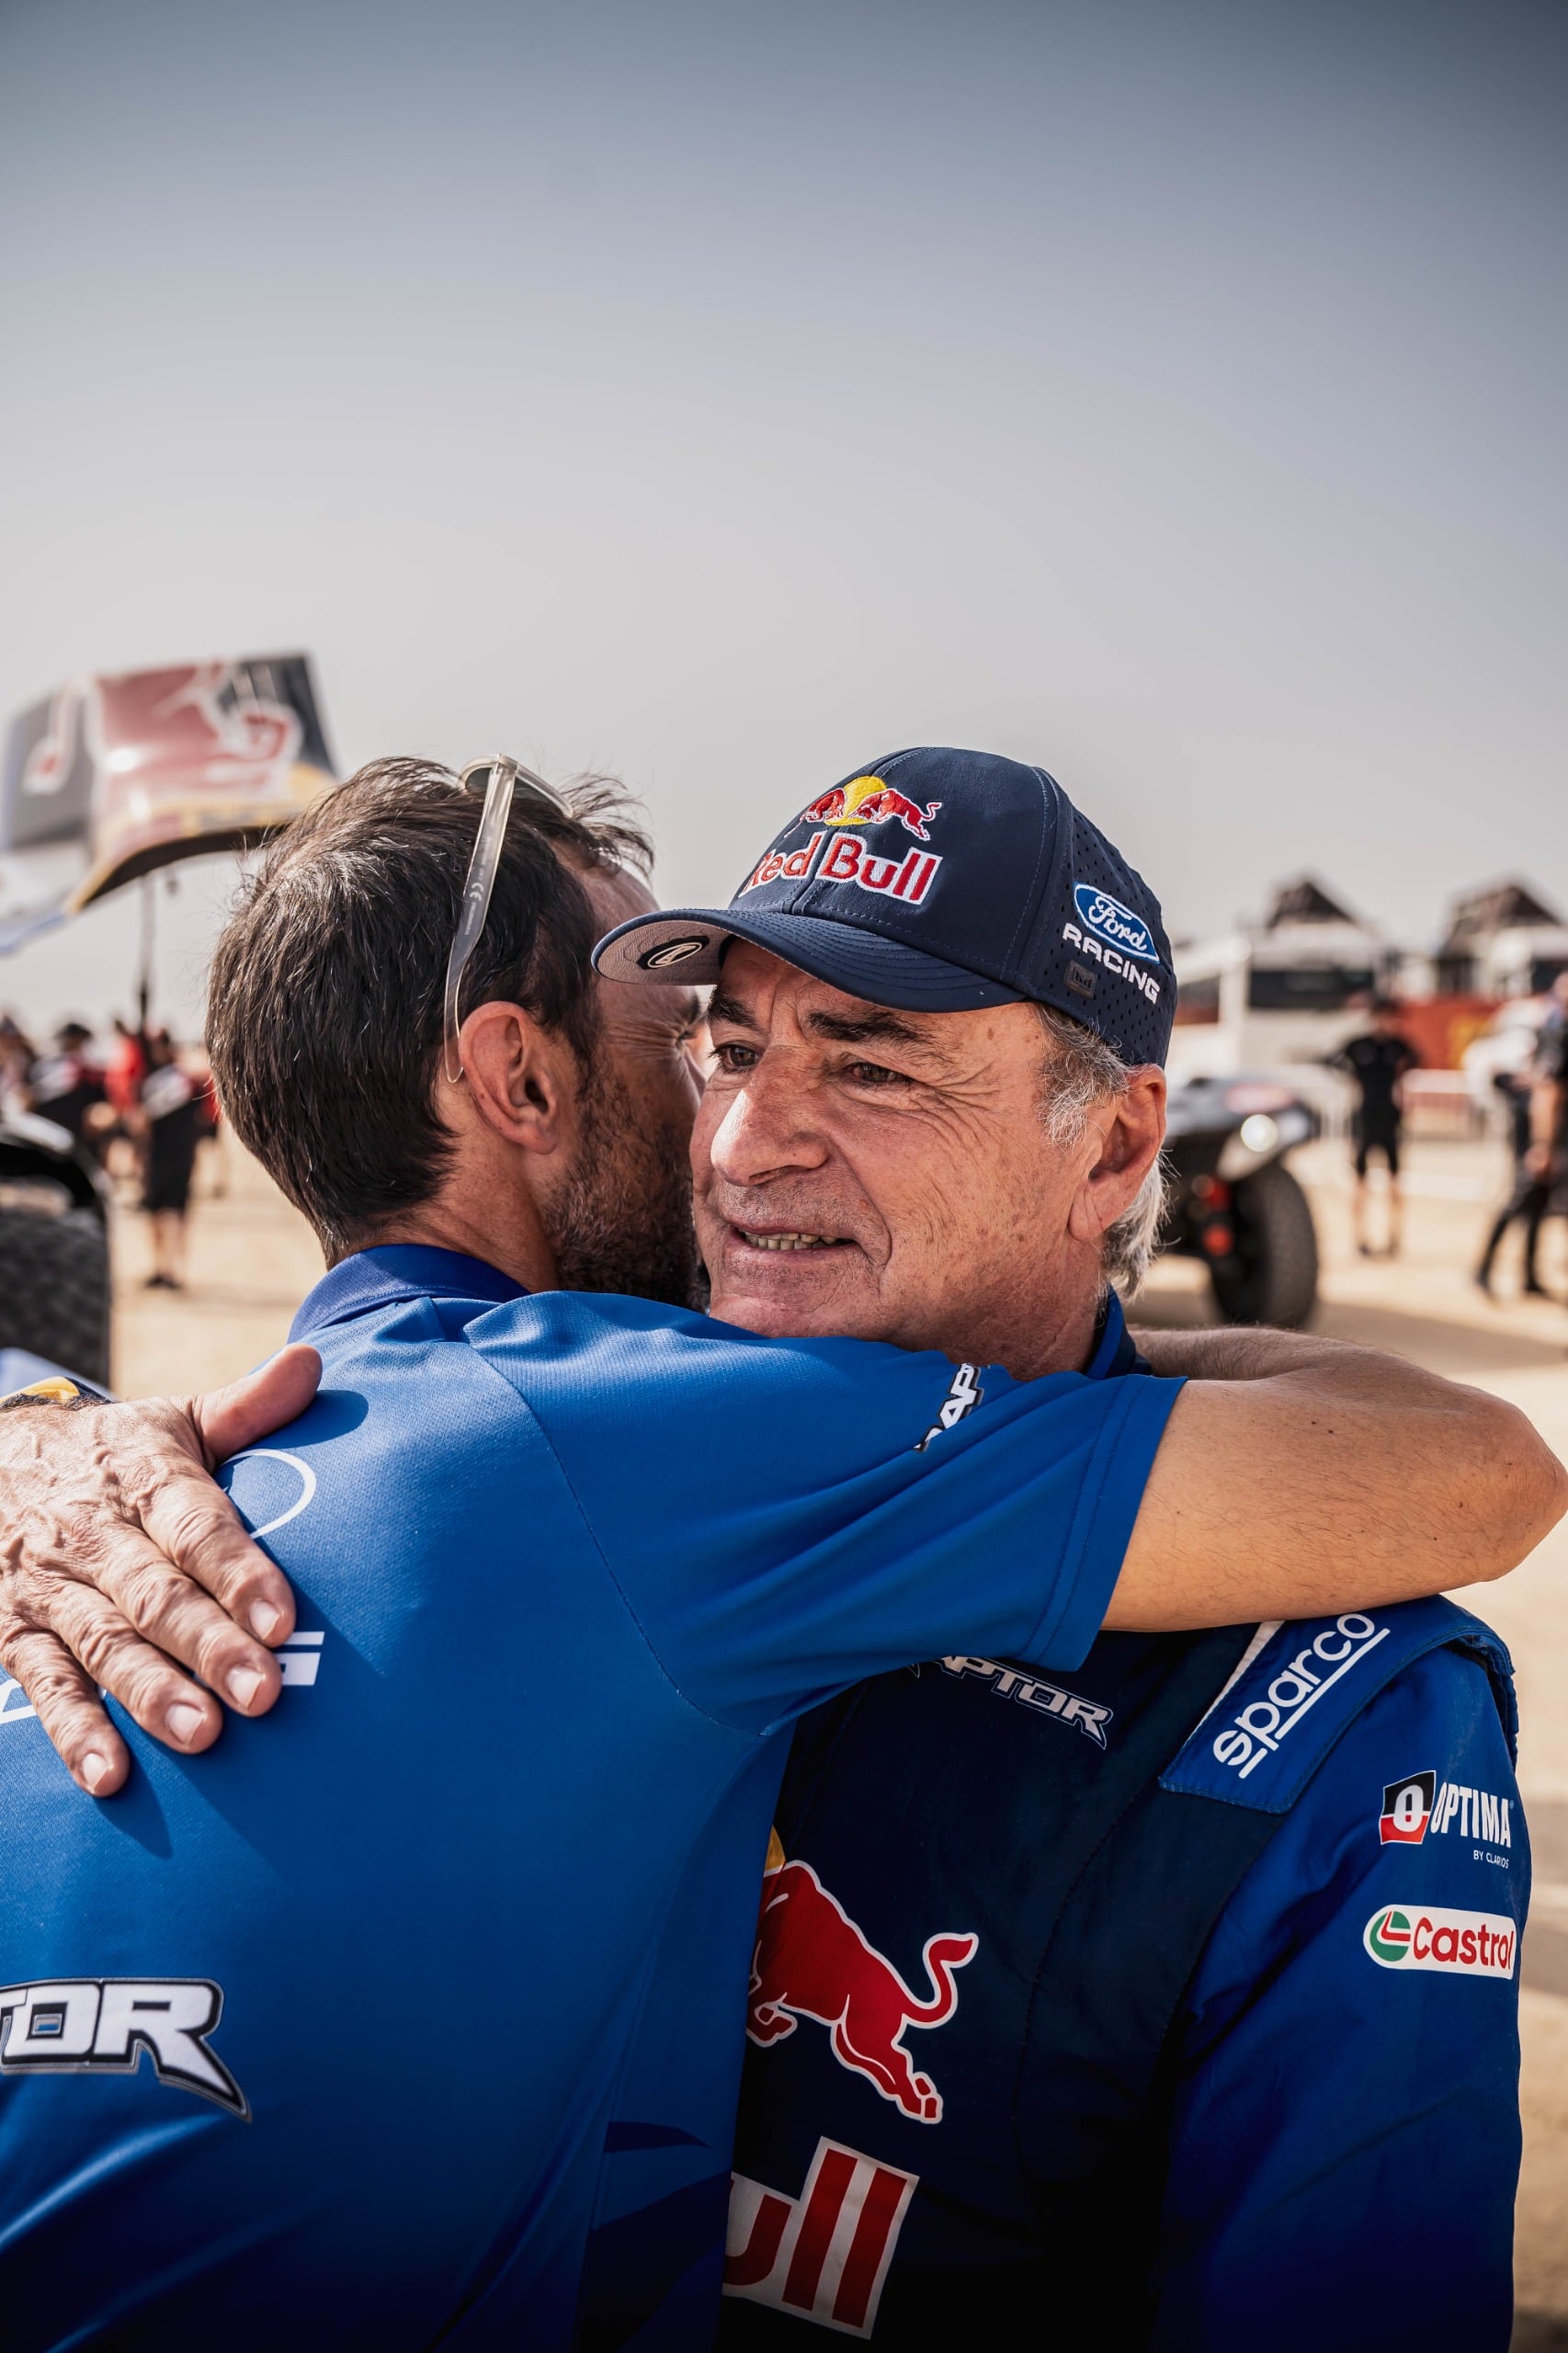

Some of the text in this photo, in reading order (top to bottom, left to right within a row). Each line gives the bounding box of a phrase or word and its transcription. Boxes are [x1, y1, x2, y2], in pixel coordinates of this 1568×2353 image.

[817, 834, 940, 904] Bull
[1088, 896, 1147, 950] Ford
[1062, 923, 1160, 1005] RACING
[1212, 1613, 1379, 1768] sparco
[1472, 1849, 1509, 1870] BY CLARIOS
[1414, 1916, 1515, 1970] Castrol
